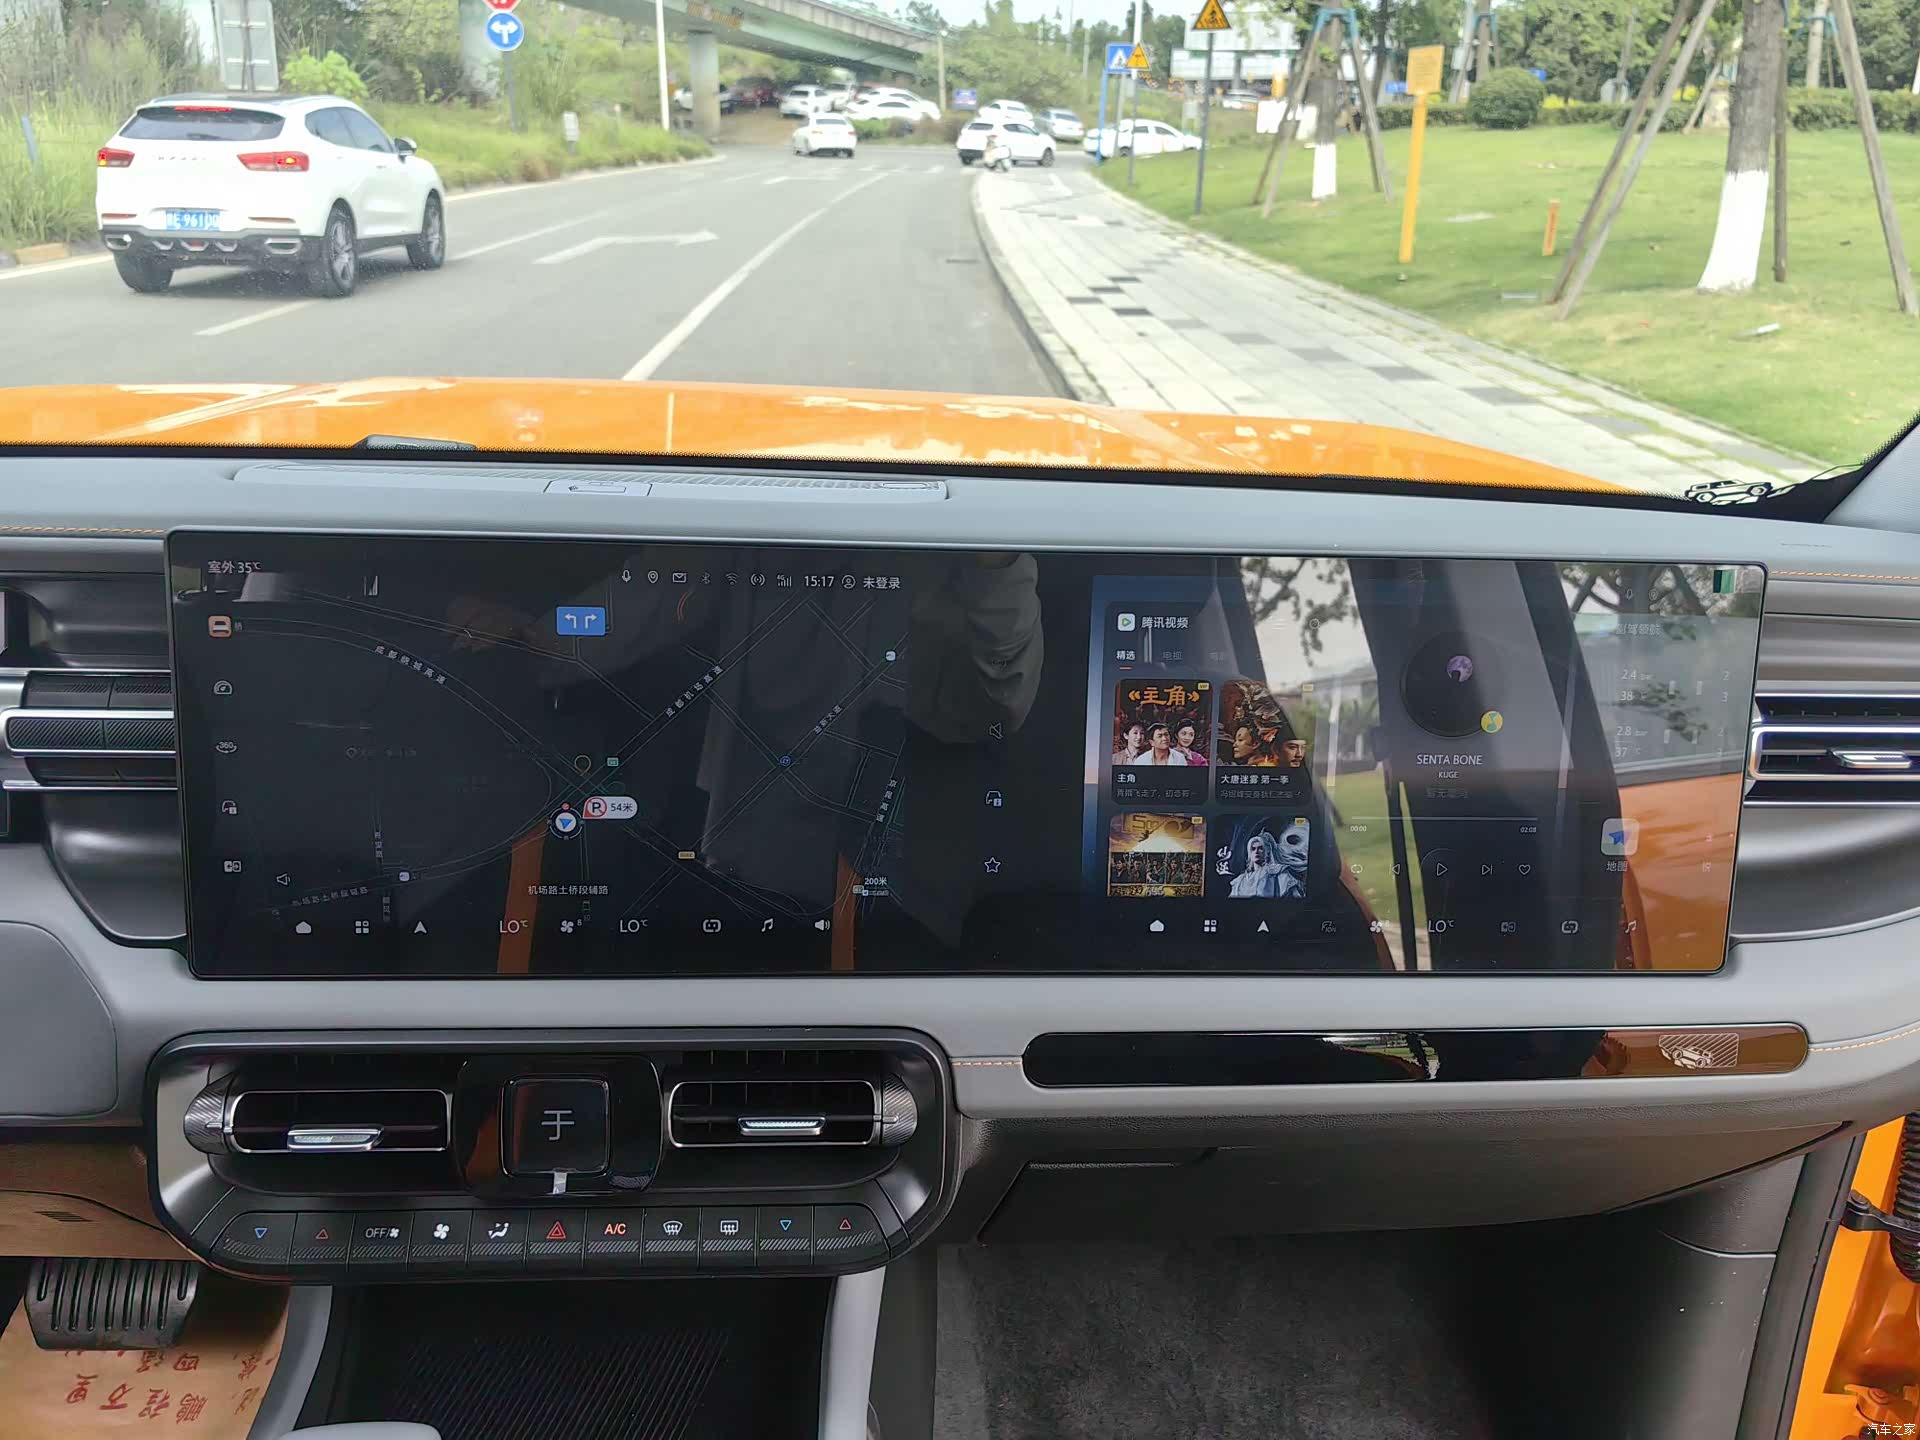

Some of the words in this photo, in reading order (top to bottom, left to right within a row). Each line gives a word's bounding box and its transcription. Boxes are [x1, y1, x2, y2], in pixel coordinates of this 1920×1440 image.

[208, 560, 235, 574] 室外
[238, 561, 261, 573] 35℃
[804, 576, 835, 587] 15:17
[863, 576, 900, 589] 未登录
[1141, 616, 1189, 629] 腾讯视频
[1116, 650, 1136, 660] 精选
[219, 741, 234, 749] 360
[1416, 754, 1450, 765] SENTA
[1453, 755, 1483, 765] BONE
[1117, 773, 1136, 783] 主角
[1220, 774, 1259, 784] 大唐迷雾
[1261, 775, 1289, 784] 第一季
[610, 803, 633, 812] 54米
[1606, 861, 1628, 872] 地图
[864, 876, 888, 886] 200米
[528, 885, 609, 895] 机场路土桥段辅路
[604, 1223, 626, 1235] A/C
